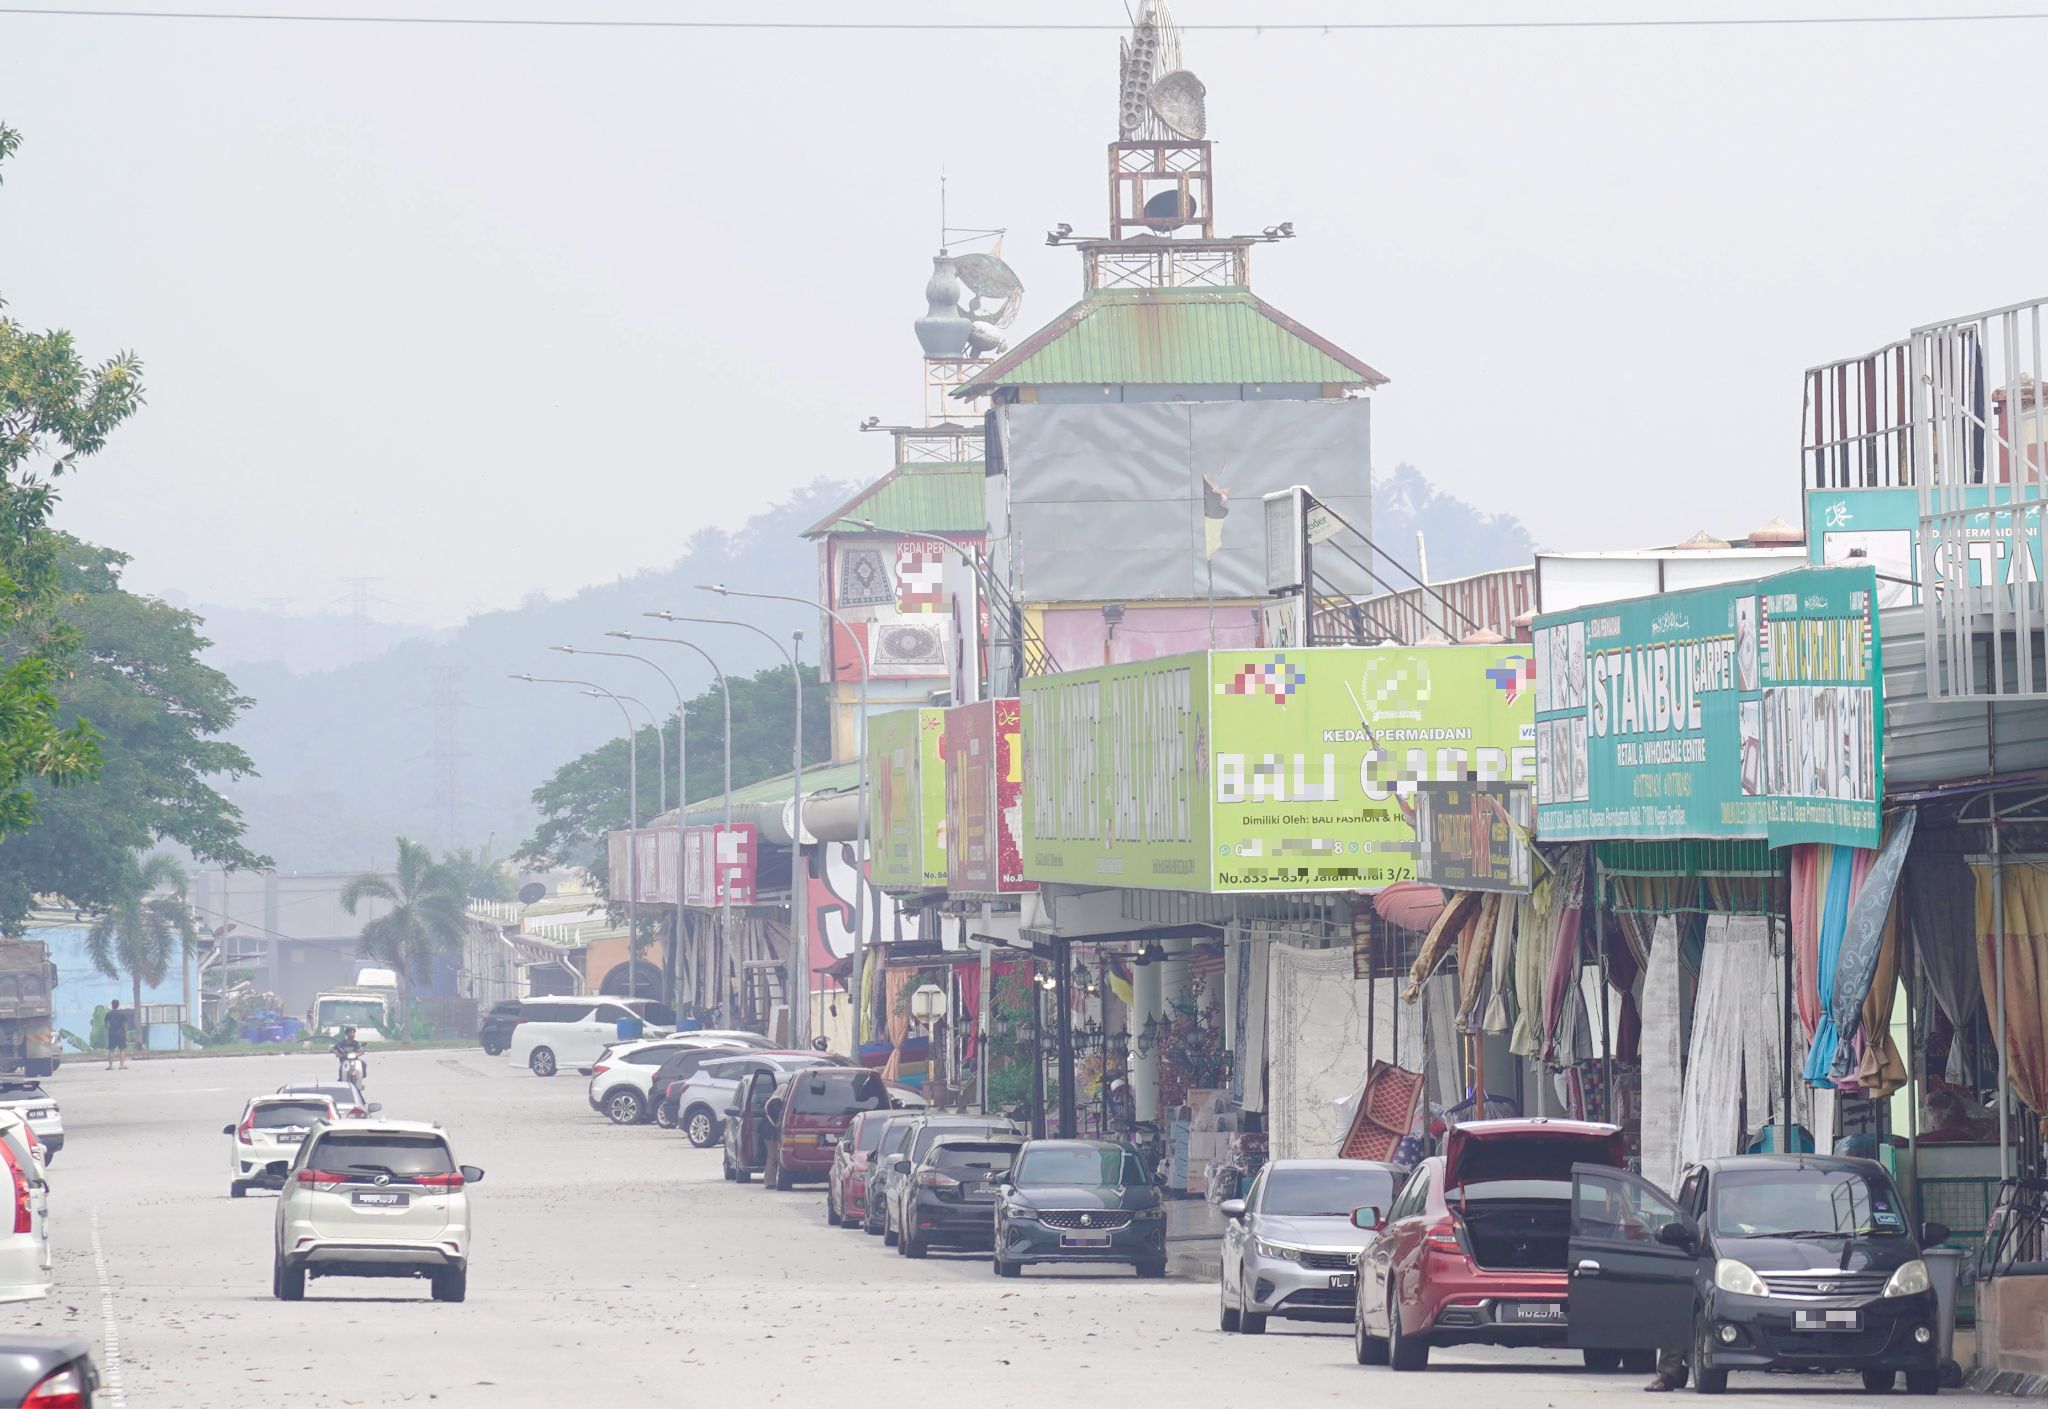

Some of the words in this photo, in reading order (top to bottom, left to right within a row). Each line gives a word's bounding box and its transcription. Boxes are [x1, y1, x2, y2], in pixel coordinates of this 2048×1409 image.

[896, 542, 925, 555] KEDAI
[1800, 616, 1839, 681] CURTAIN
[1840, 615, 1866, 681] HOME
[1586, 640, 1702, 739] ISTANBUL
[1693, 634, 1736, 694] CARPET
[1375, 727, 1472, 742] PERMAIDANI
[1143, 667, 1192, 845] CARPET
[1617, 741, 1638, 767] RETAIL
[1644, 739, 1682, 765] WHOLESALE
[1682, 737, 1706, 763] CENTRE
[1242, 814, 1280, 826] Dimiliki
[1283, 815, 1309, 825] Oleh:
